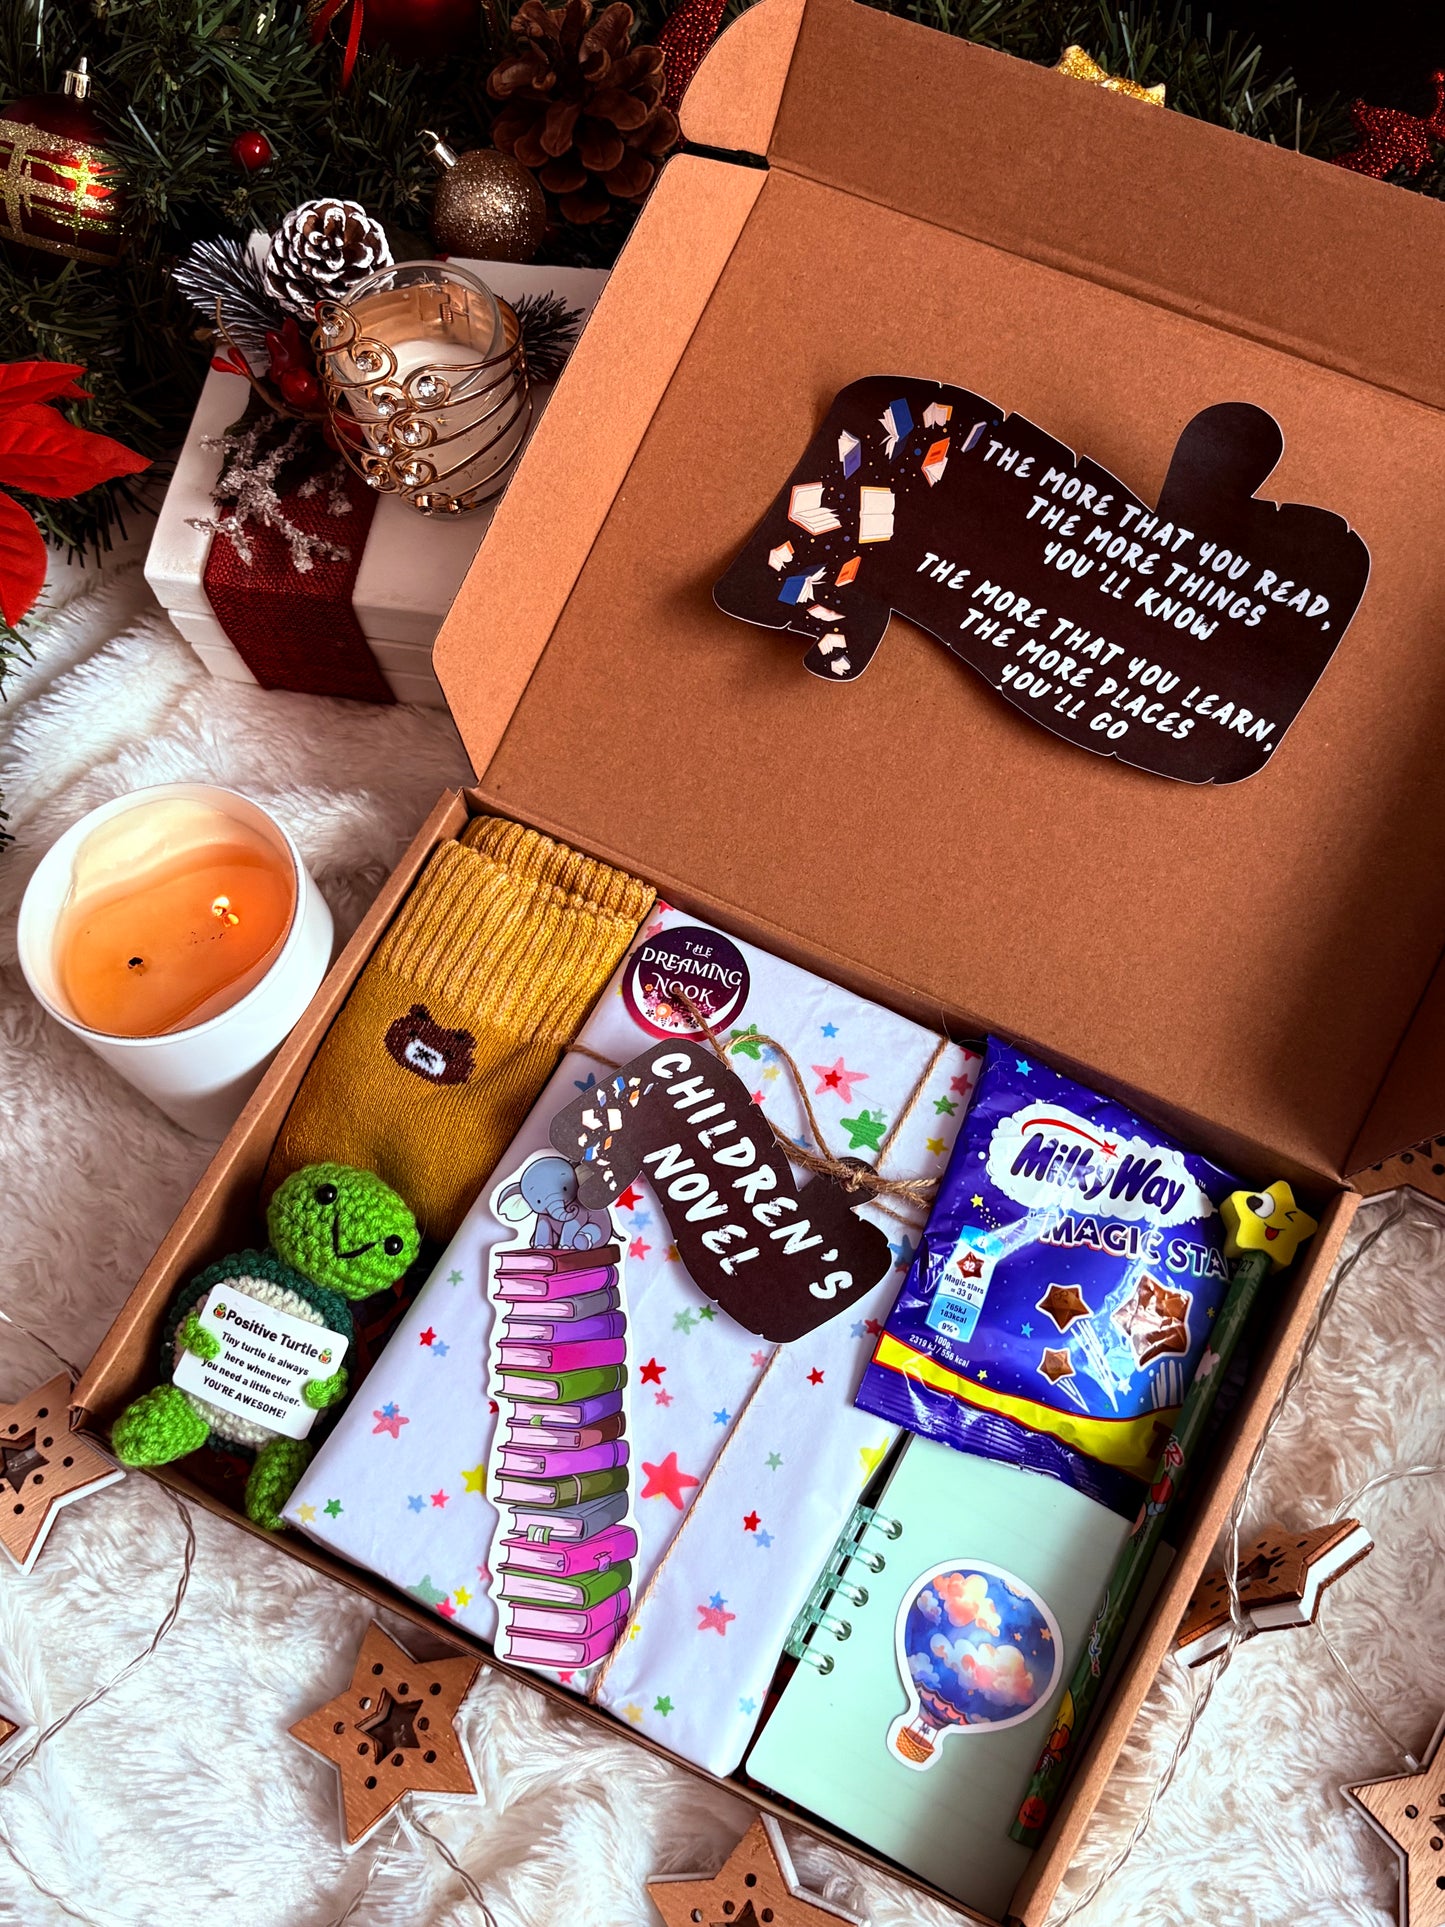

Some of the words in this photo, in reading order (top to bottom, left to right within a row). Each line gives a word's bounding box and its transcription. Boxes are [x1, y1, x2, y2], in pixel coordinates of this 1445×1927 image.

[983, 440, 1035, 478] THE
[1038, 467, 1113, 516] MORE
[1119, 503, 1195, 553] THAT
[1198, 542, 1251, 580] YOU
[1253, 569, 1331, 632] READ,
[1026, 496, 1081, 537] THE
[1084, 526, 1161, 575] MORE
[1164, 562, 1268, 628] THINGS
[1042, 541, 1131, 600] YOU'LL
[1134, 587, 1220, 641] KNOW
[916, 552, 971, 590] THE
[971, 580, 1048, 629] MORE
[1054, 617, 1125, 667] THAT
[1127, 656, 1180, 695] YOU
[1181, 686, 1277, 752] LEARN,
[960, 607, 1015, 648] THE
[1016, 638, 1093, 688] MORE
[1094, 677, 1194, 740] PLACES
[1001, 663, 1086, 721] YOU'LL
[1088, 712, 1130, 740] GO
[641, 947, 742, 988] DREAMING
[685, 942, 713, 958] THE
[652, 972, 716, 1008] NOOK
[651, 1053, 853, 1300] CHILDREN'S
[643, 1143, 760, 1276] NOVEL
[963, 1261, 975, 1272] 32
[1039, 1216, 1163, 1265] MAGIC
[1168, 1238, 1234, 1283] STA
[945, 1273, 966, 1290] Magic
[967, 1283, 984, 1295] stars
[957, 1288, 966, 1296] 33
[222, 1332, 240, 1348] Tiny
[241, 1341, 266, 1359] turtle
[268, 1352, 276, 1362] is
[277, 1356, 309, 1376] always
[226, 1310, 278, 1341] Positive
[281, 1334, 318, 1358] Turtle
[202, 1358, 218, 1372] you
[219, 1366, 243, 1382] need
[242, 1377, 248, 1385] a
[250, 1380, 272, 1395] little
[272, 1390, 300, 1407] cheer.
[225, 1351, 244, 1367] here
[247, 1361, 291, 1386] whenever
[954, 1354, 970, 1368] kcal
[203, 1376, 235, 1397] YOU'RE
[235, 1392, 287, 1419] AWESOME!
